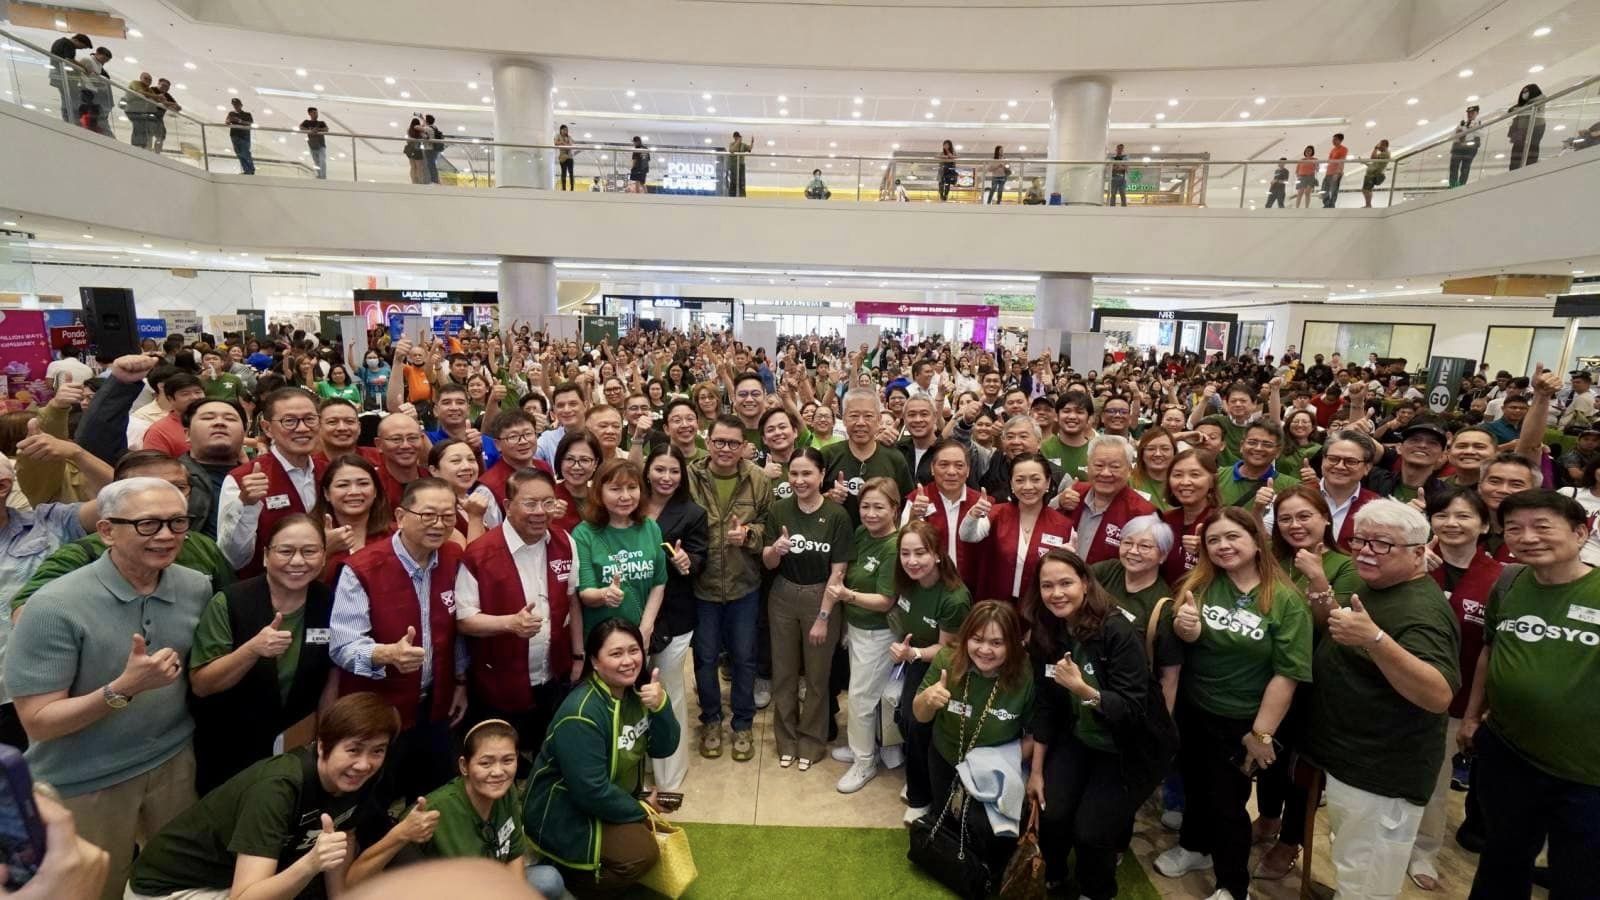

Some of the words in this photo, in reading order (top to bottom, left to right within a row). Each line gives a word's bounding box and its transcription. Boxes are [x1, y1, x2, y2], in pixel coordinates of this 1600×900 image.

[668, 162, 715, 176] POUND
[141, 324, 163, 332] GCash
[788, 534, 831, 554] GOSYO
[1495, 615, 1600, 646] NEGOSYO
